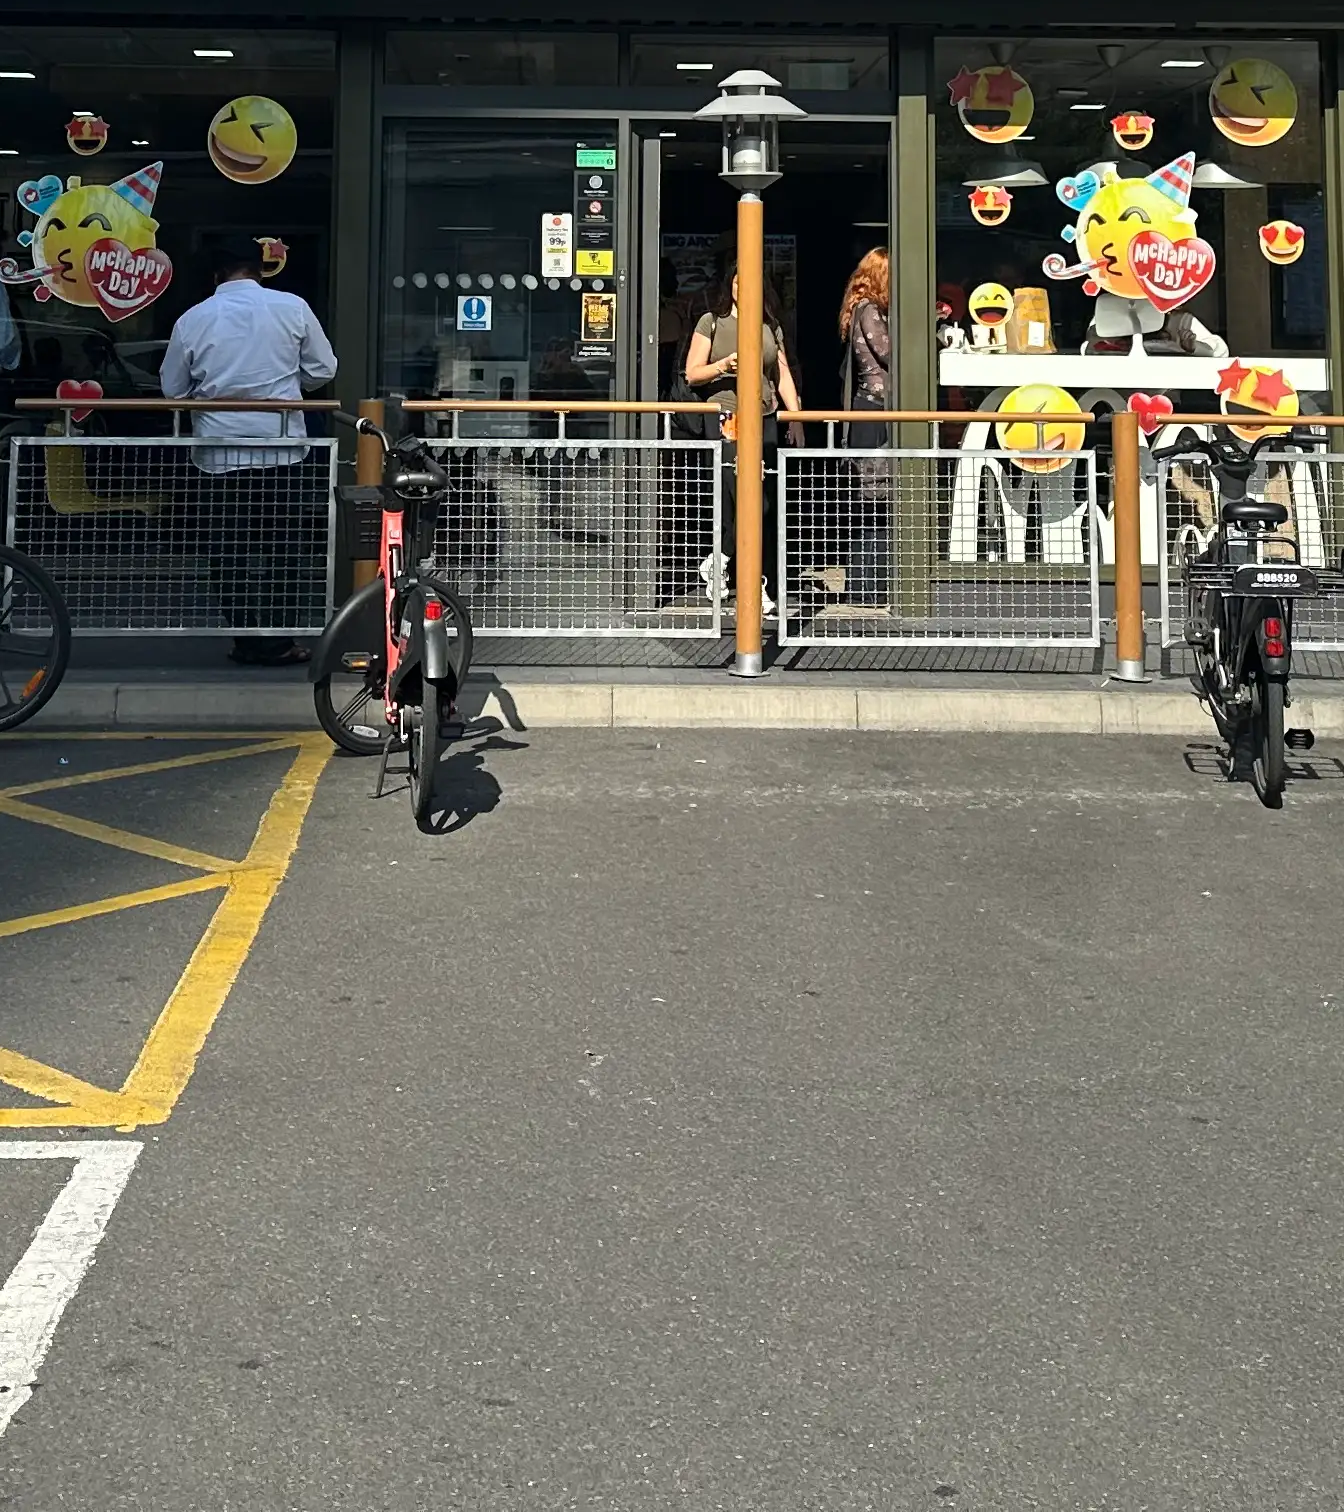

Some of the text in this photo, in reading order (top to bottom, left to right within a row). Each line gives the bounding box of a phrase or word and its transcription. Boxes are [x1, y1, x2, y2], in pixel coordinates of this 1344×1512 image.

[90, 250, 165, 285] McHappy
[1134, 241, 1207, 275] McHappy
[108, 271, 140, 297] Day
[1153, 263, 1184, 288] Day
[1256, 573, 1298, 583] 888520
